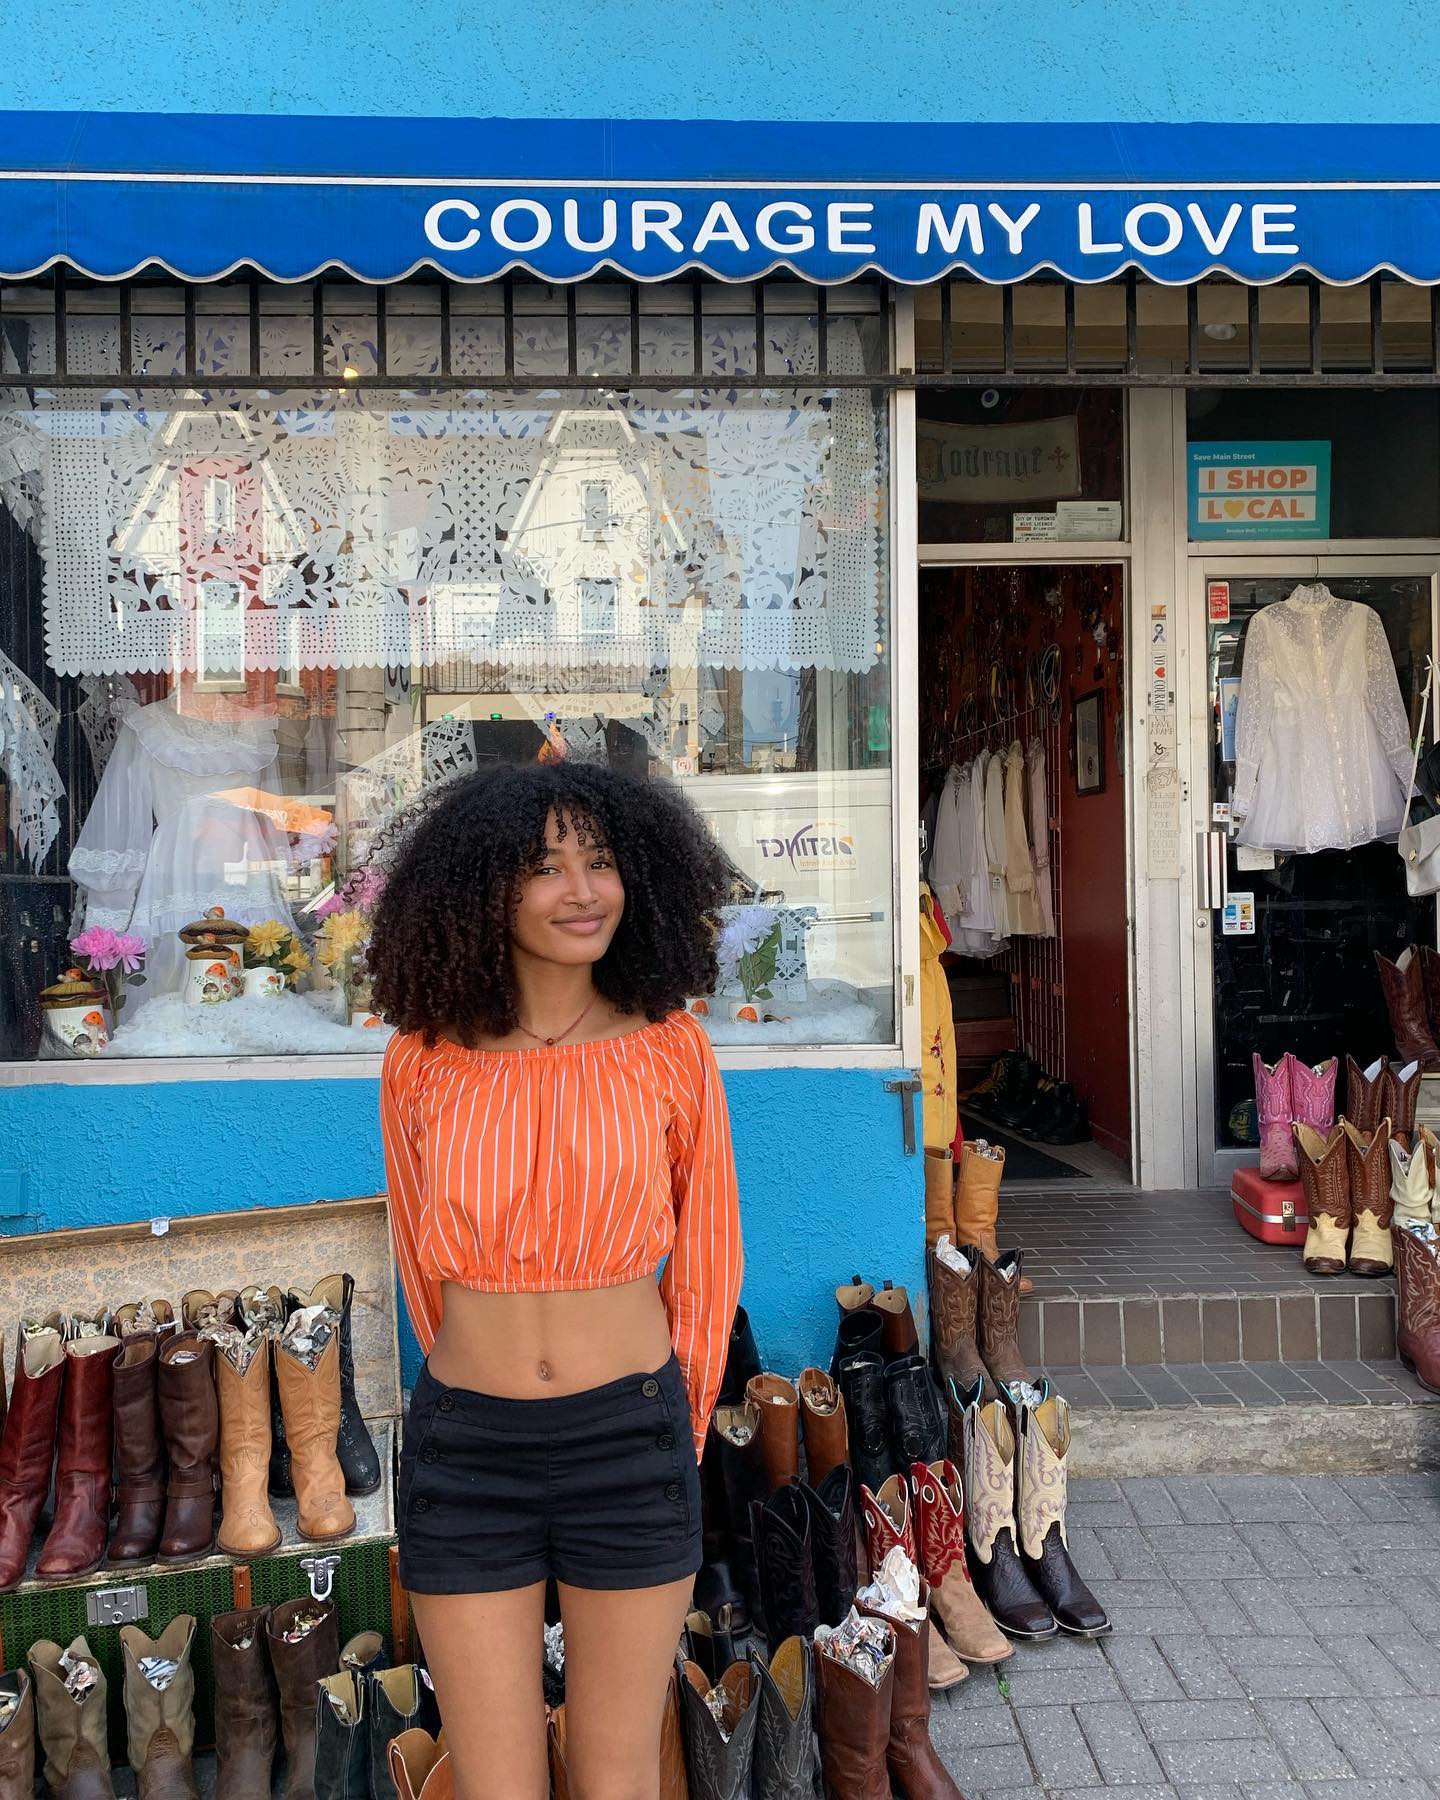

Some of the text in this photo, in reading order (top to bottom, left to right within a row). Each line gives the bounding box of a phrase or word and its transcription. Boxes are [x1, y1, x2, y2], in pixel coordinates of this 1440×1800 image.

[424, 199, 1299, 256] COURAGE MY LOVE
[1193, 453, 1212, 461] Save
[1212, 453, 1232, 461] Main
[1208, 469, 1308, 490] I SHOP
[1153, 679, 1166, 712] COURAGE
